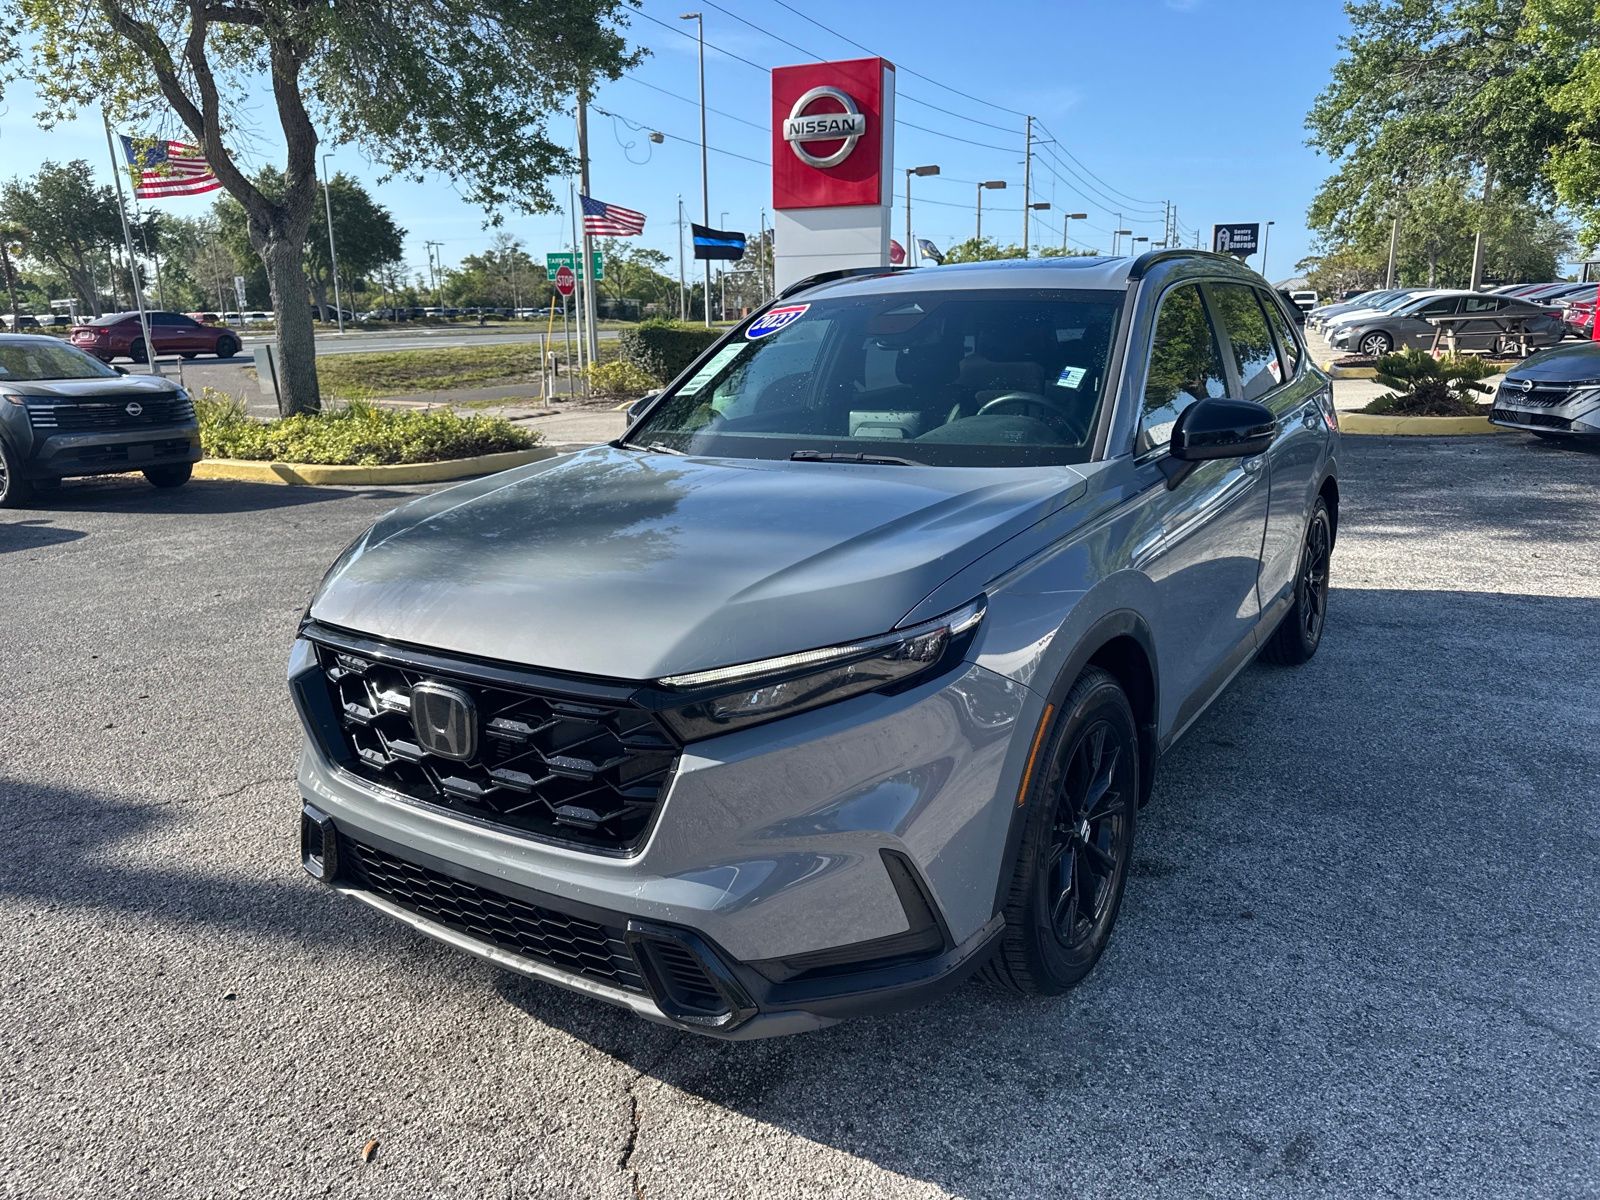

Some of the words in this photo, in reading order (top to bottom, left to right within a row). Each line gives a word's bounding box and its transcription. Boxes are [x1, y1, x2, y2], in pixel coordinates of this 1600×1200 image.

[790, 119, 855, 135] NISSAN
[1230, 241, 1255, 249] Storage
[557, 275, 573, 286] STOP
[751, 312, 795, 330] 2023
